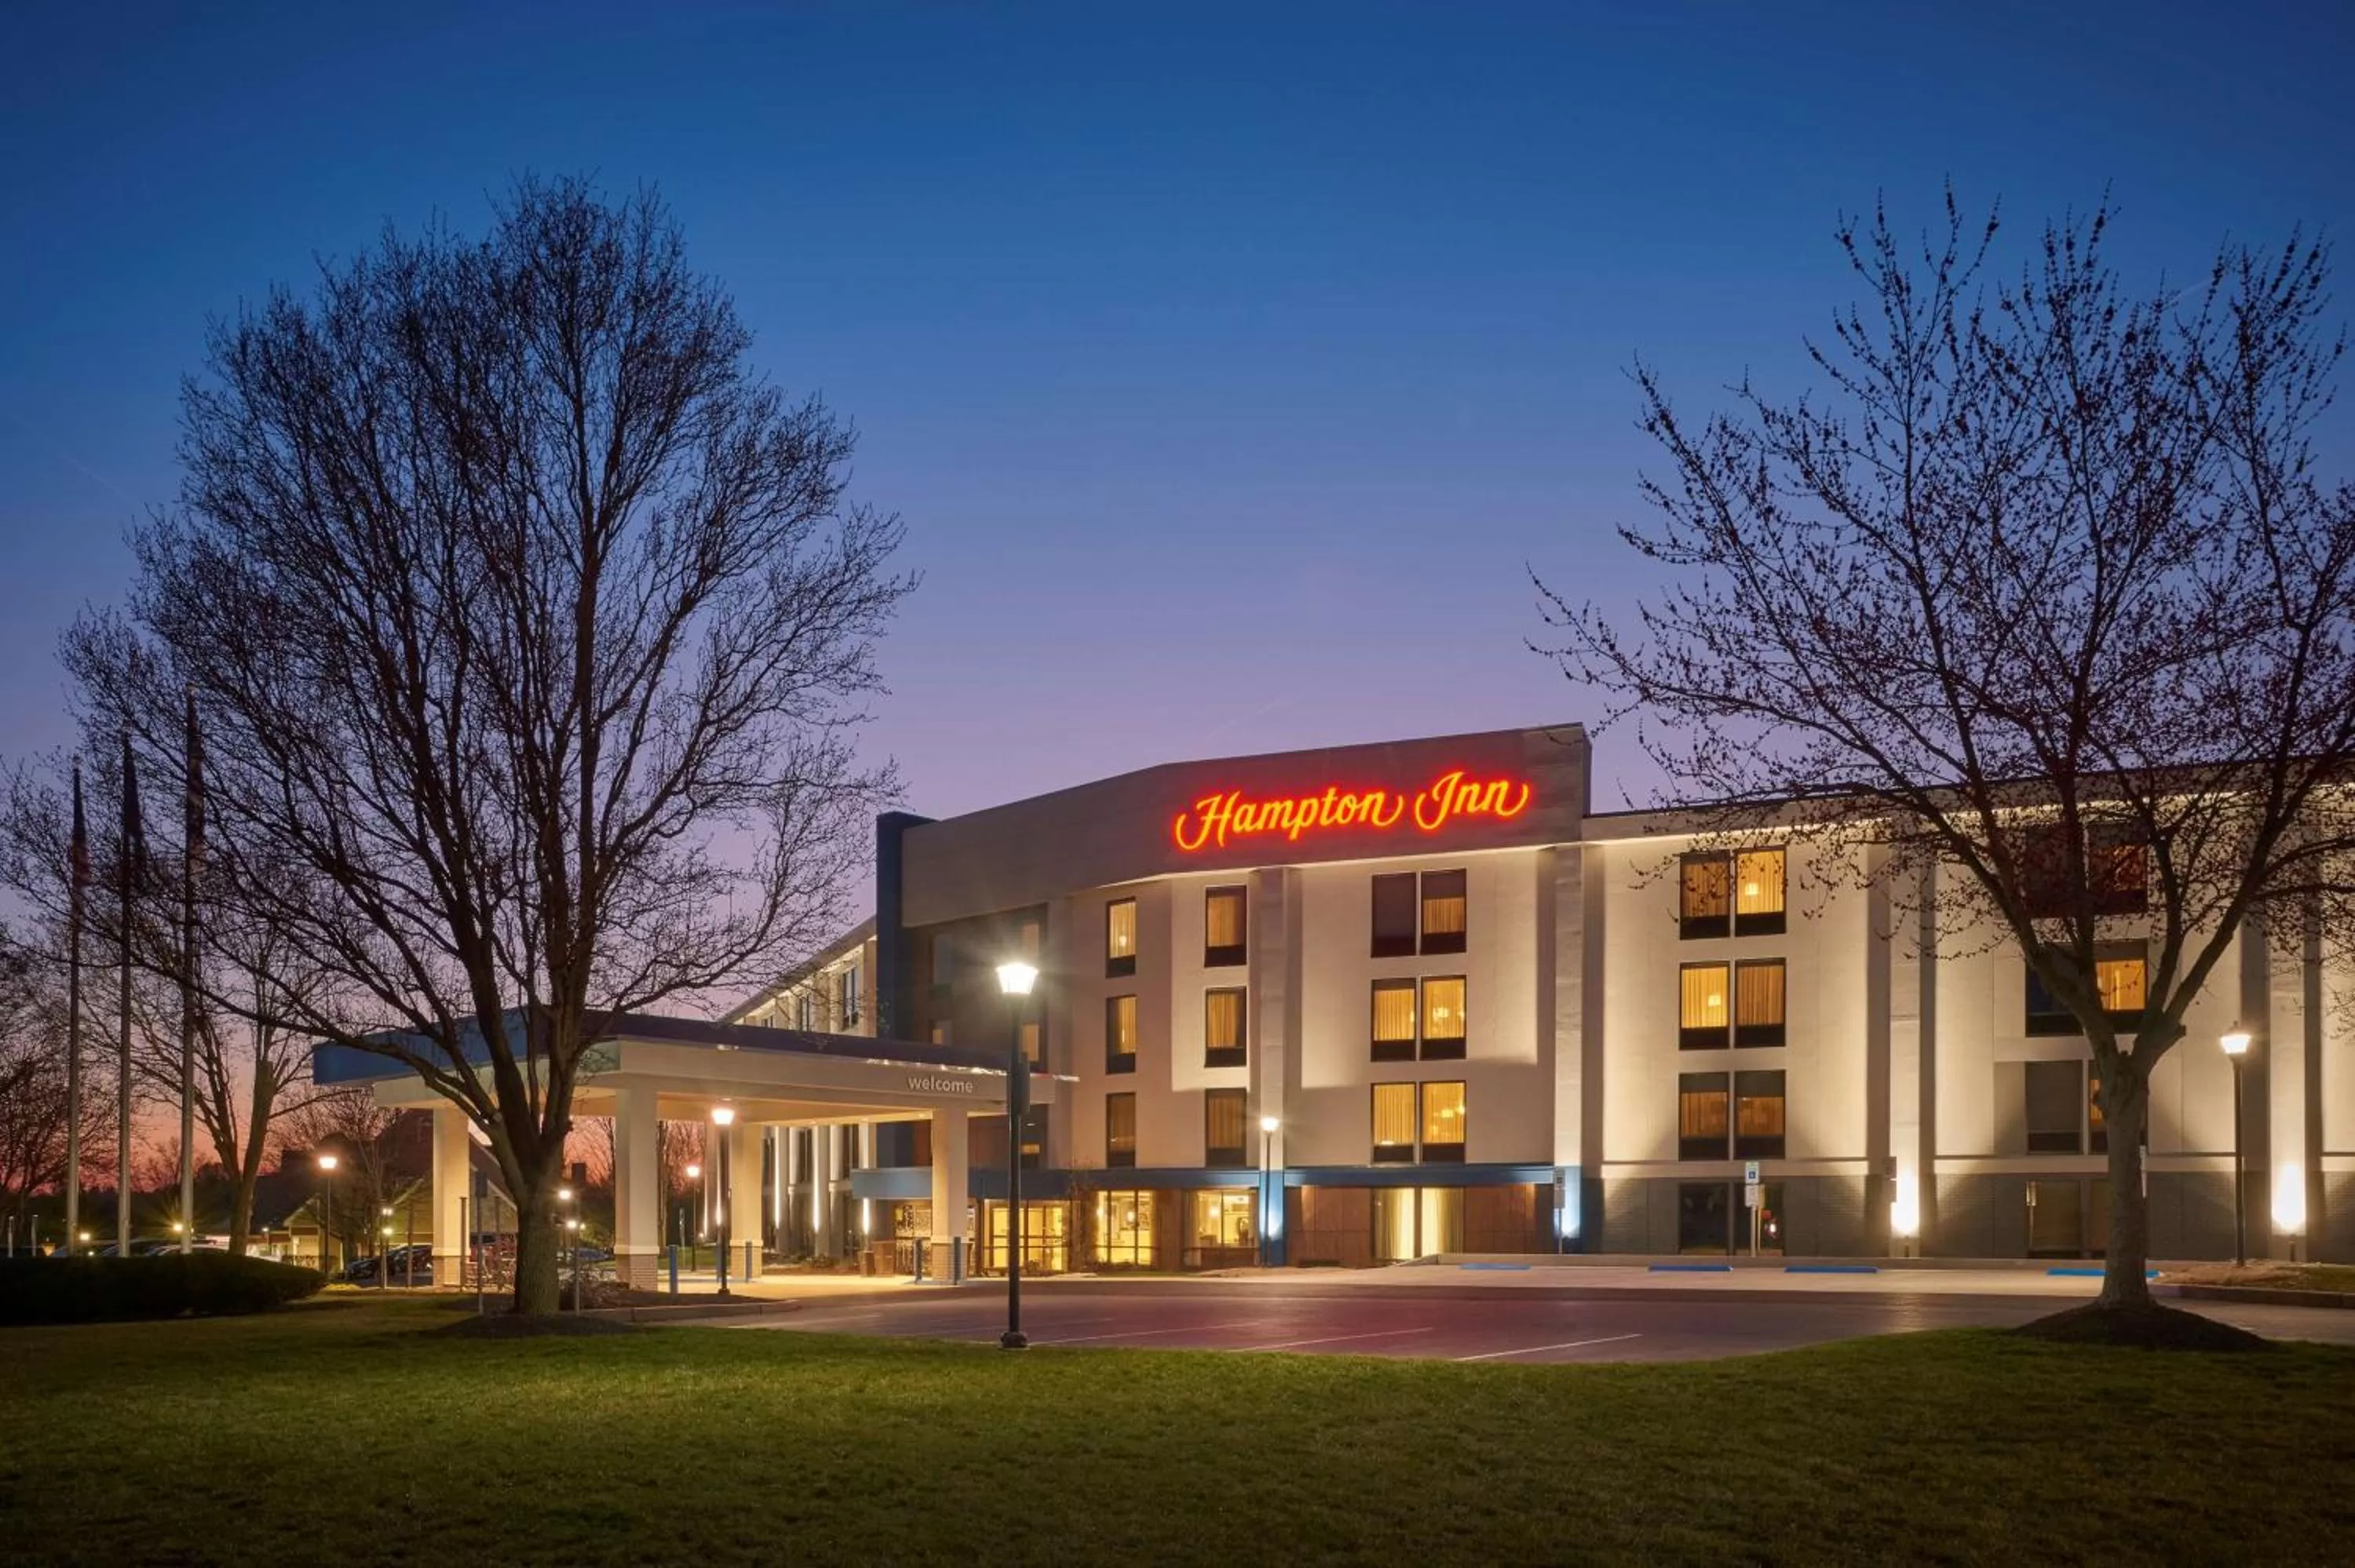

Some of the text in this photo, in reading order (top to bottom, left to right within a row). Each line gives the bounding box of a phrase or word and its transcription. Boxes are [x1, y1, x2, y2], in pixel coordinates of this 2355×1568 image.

[1176, 771, 1529, 850] Hampton Inn
[907, 1074, 973, 1092] welcome
